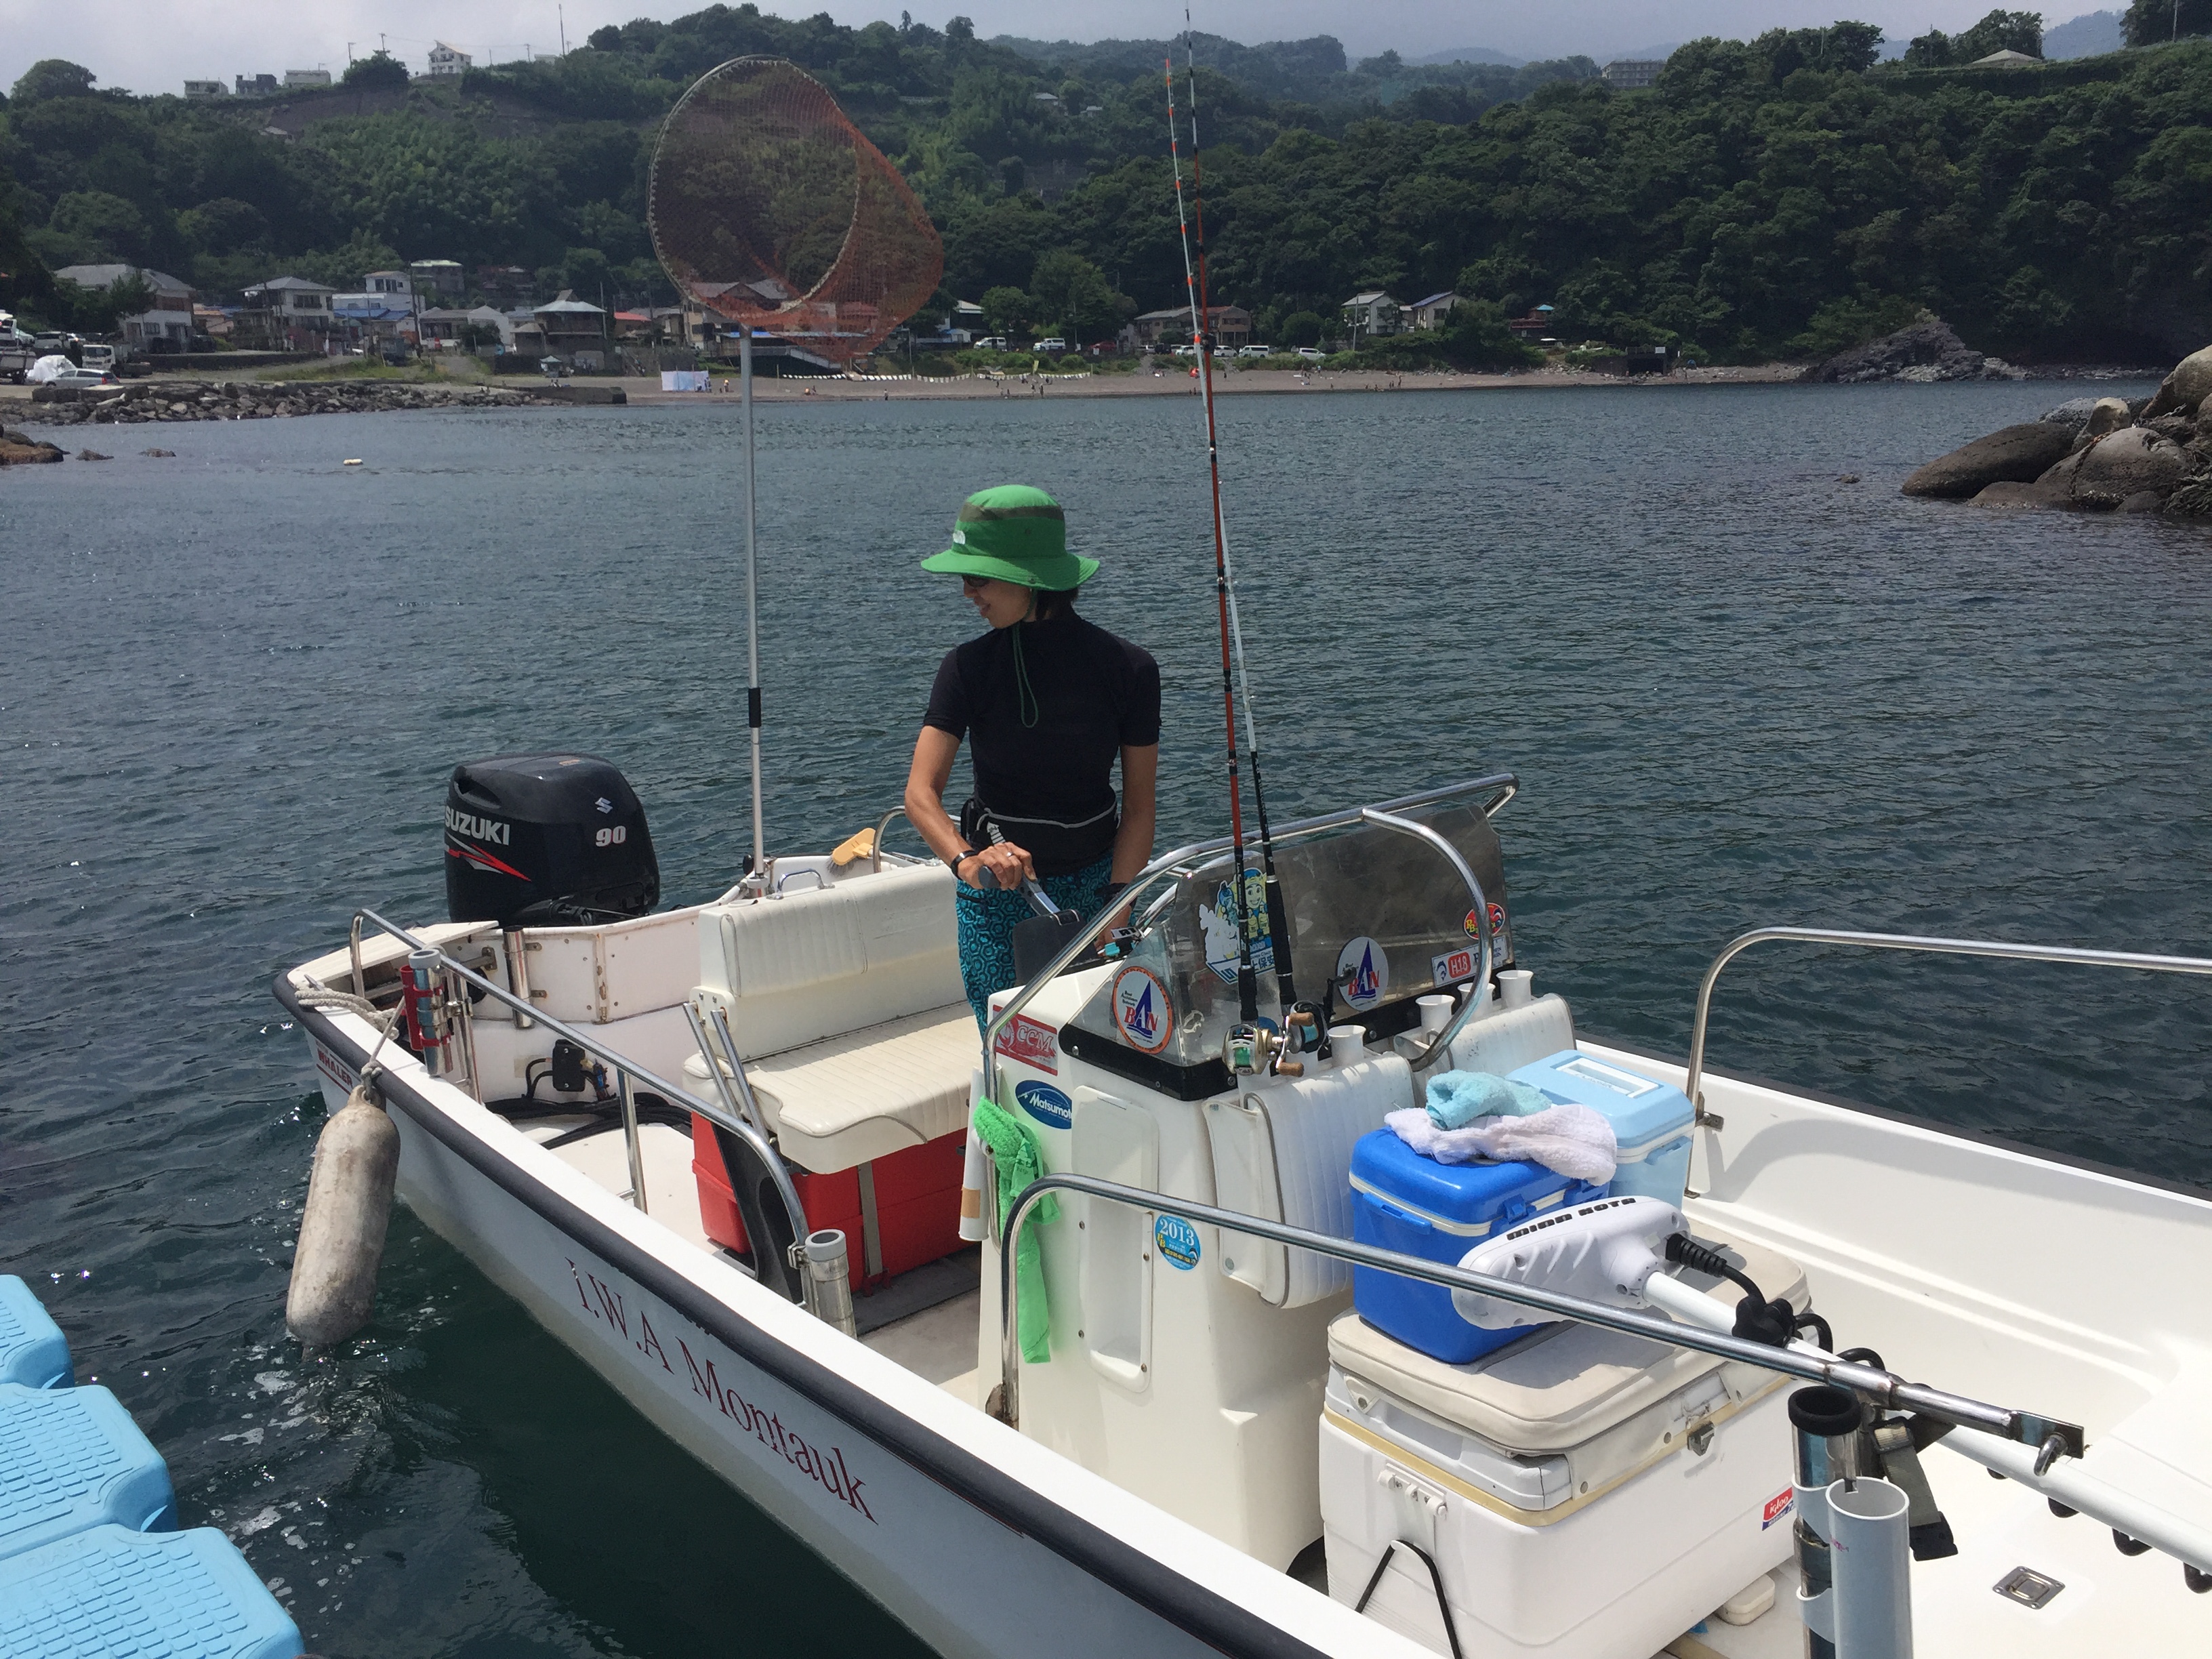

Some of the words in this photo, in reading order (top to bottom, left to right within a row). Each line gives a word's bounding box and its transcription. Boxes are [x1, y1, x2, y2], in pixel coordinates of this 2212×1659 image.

[445, 805, 510, 846] SUZUKI
[595, 825, 627, 847] 90
[1347, 969, 1380, 996] BAN
[1124, 1006, 1160, 1032] BAN
[1160, 1218, 1195, 1246] 2013
[675, 1336, 879, 1526] Montauk
[1769, 1496, 1789, 1515] igloo
